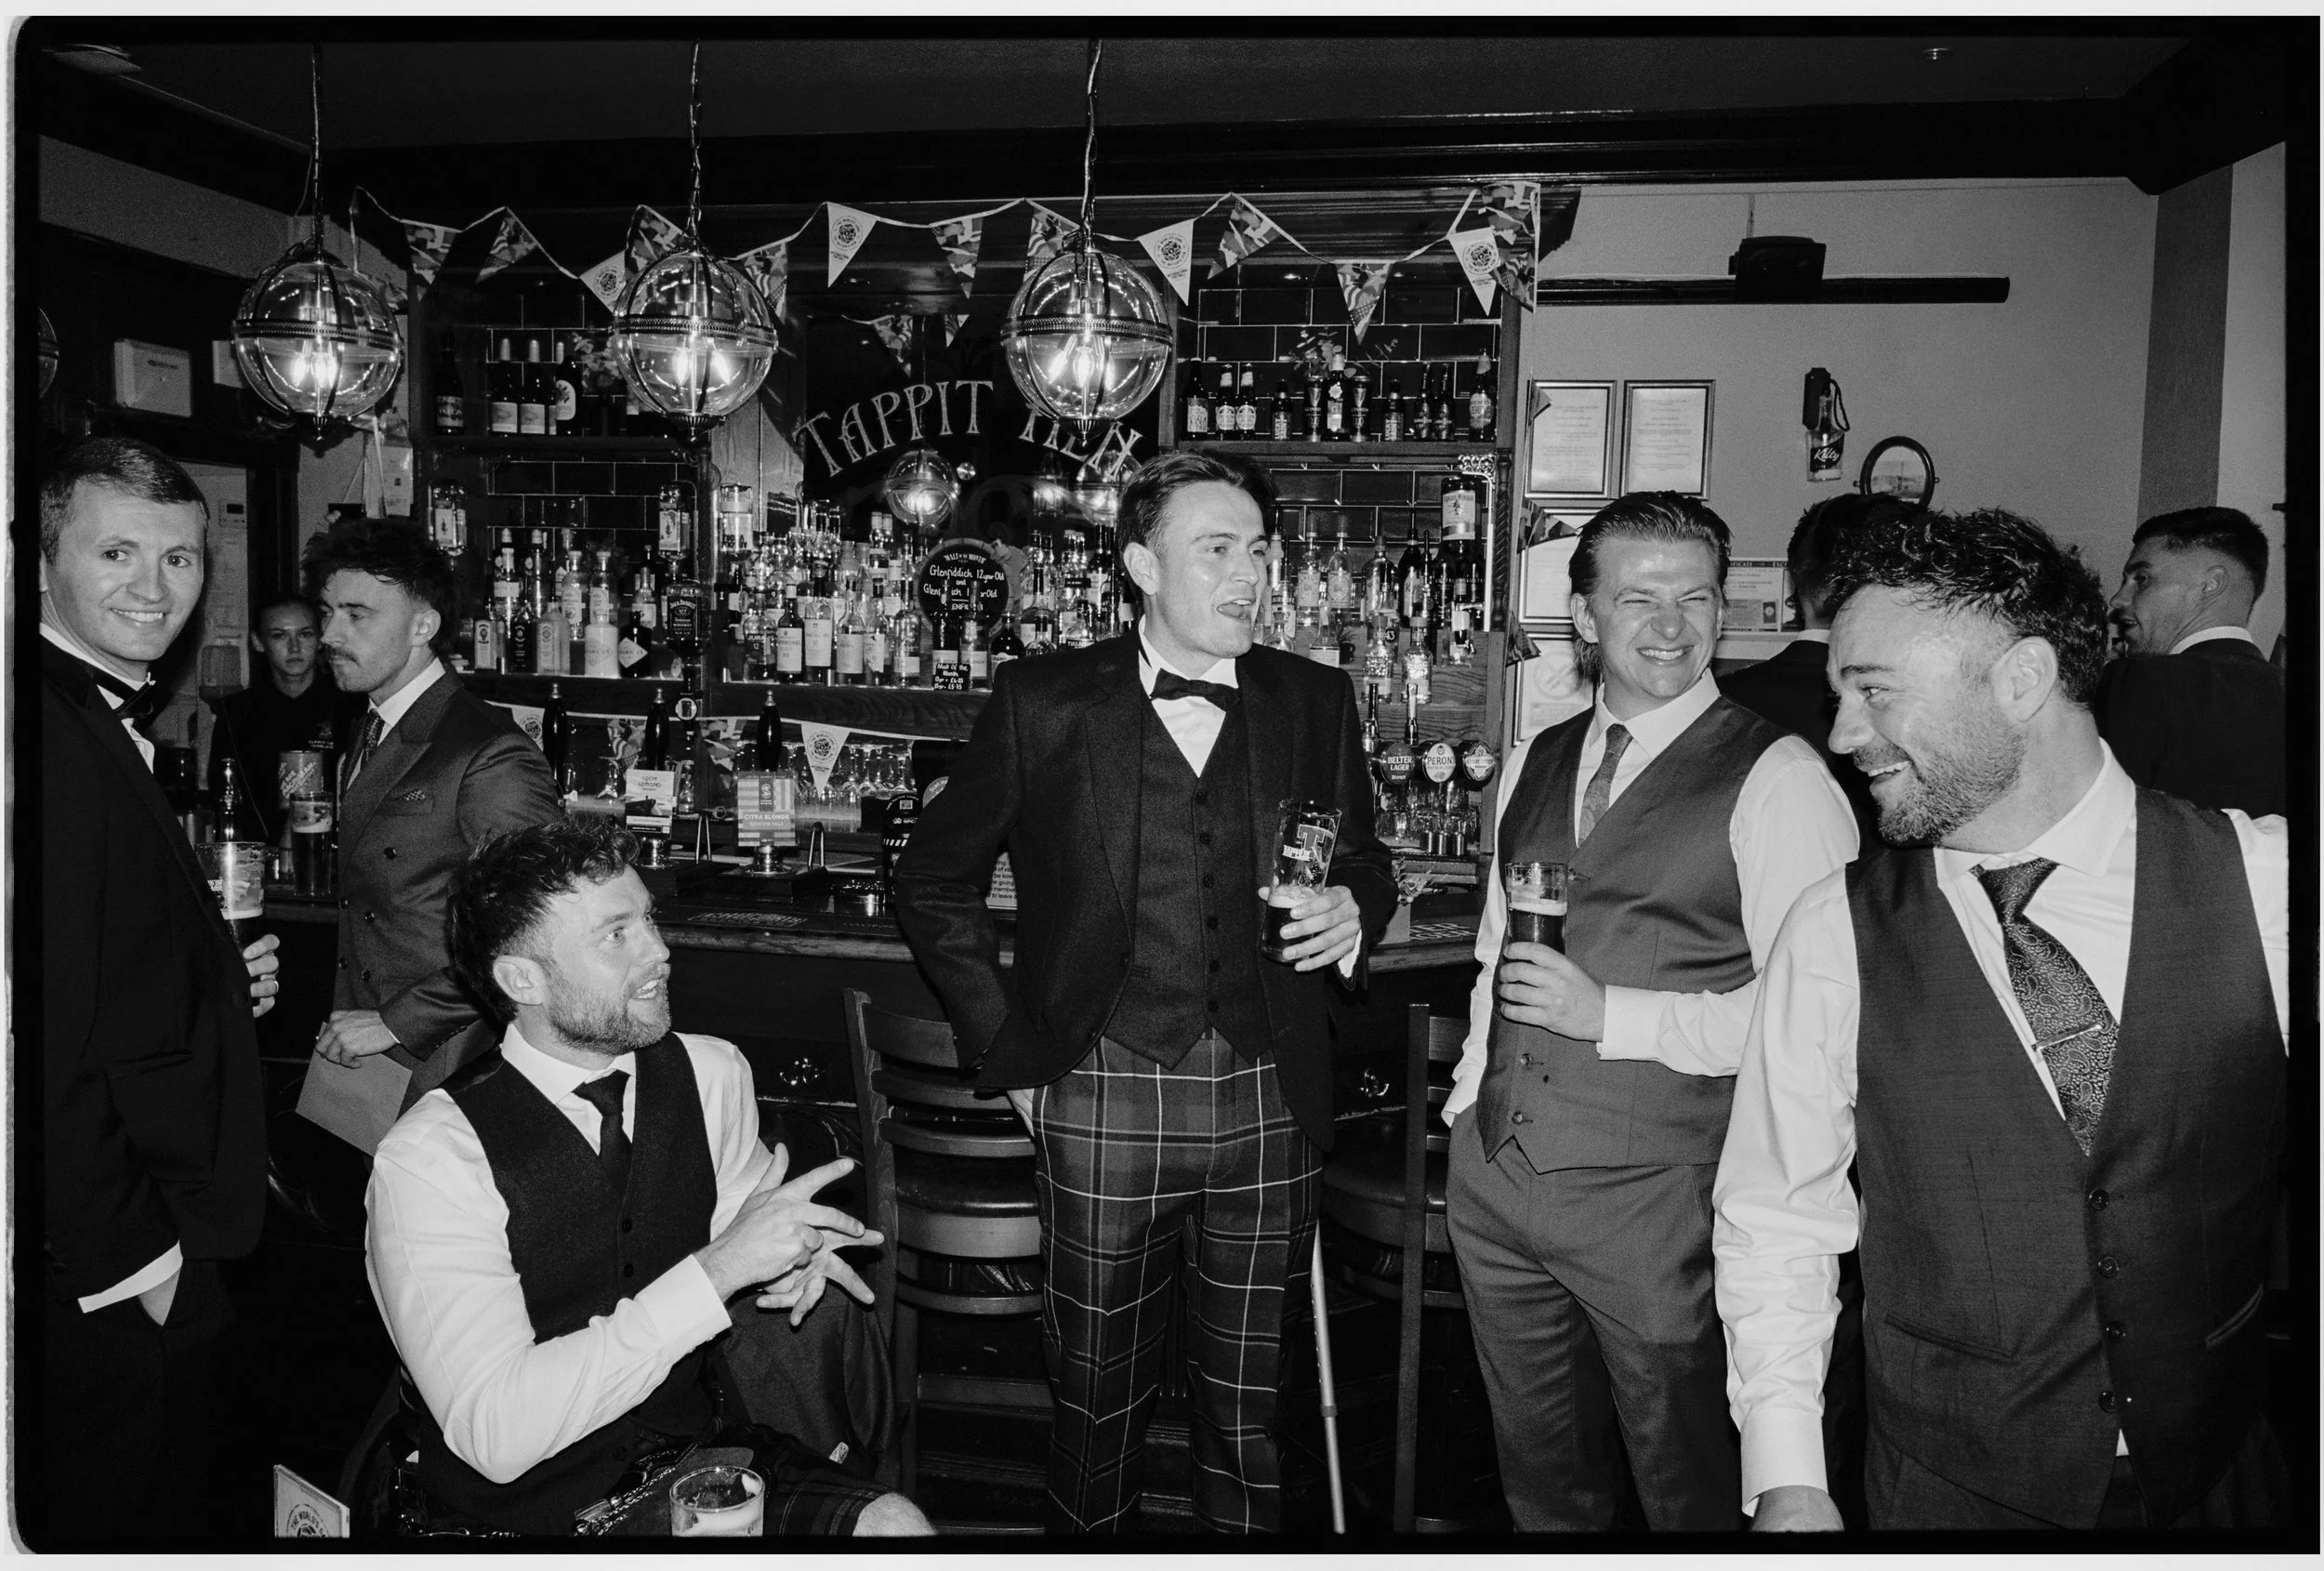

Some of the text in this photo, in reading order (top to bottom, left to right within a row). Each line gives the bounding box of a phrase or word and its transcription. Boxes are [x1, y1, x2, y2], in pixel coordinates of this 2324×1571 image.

[792, 380, 994, 478] TAPPIT
[930, 564, 973, 580] Glenfiddich
[1387, 755, 1413, 764] BELTER
[1426, 756, 1455, 765] PERON
[1390, 763, 1410, 772] LAGER
